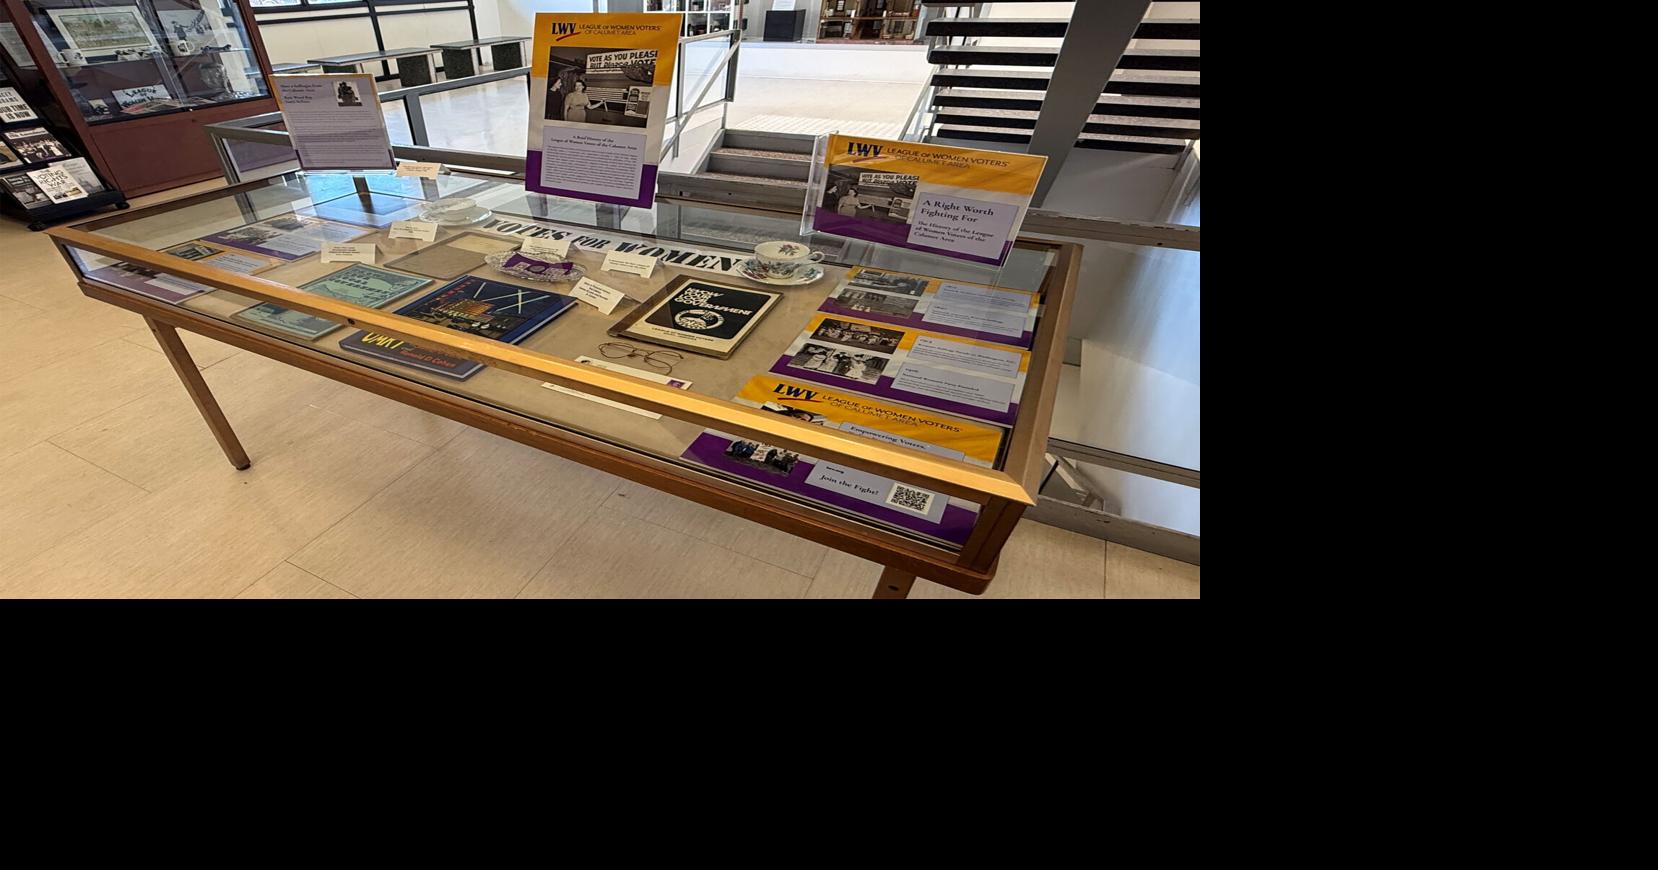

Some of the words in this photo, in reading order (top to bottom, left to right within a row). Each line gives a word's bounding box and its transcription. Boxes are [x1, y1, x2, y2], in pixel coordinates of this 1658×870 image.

[552, 22, 577, 34] LWV
[847, 142, 883, 157] LWV
[887, 148, 920, 156] LEAGUE
[931, 153, 969, 162] WOMEN
[34, 170, 64, 180] VOTING
[38, 174, 68, 185] RIGHTS
[921, 208, 958, 221] Fighting
[934, 201, 960, 210] Right
[964, 206, 994, 216] Worth
[483, 219, 572, 240] VOTES
[572, 235, 611, 249] FOR
[615, 241, 743, 271] WOMEN
[679, 294, 708, 303] LOCAL
[688, 287, 725, 297] KNOW
[674, 297, 752, 315] GOVERNMENT
[773, 383, 818, 400] LWV
[822, 395, 860, 408] LEAGUE
[875, 407, 918, 422] WOMEN
[918, 419, 960, 433] VOTERS
[851, 426, 898, 442] Empowering
[820, 475, 837, 483] Join
[839, 479, 852, 487] the
[854, 484, 879, 495] Fight!
